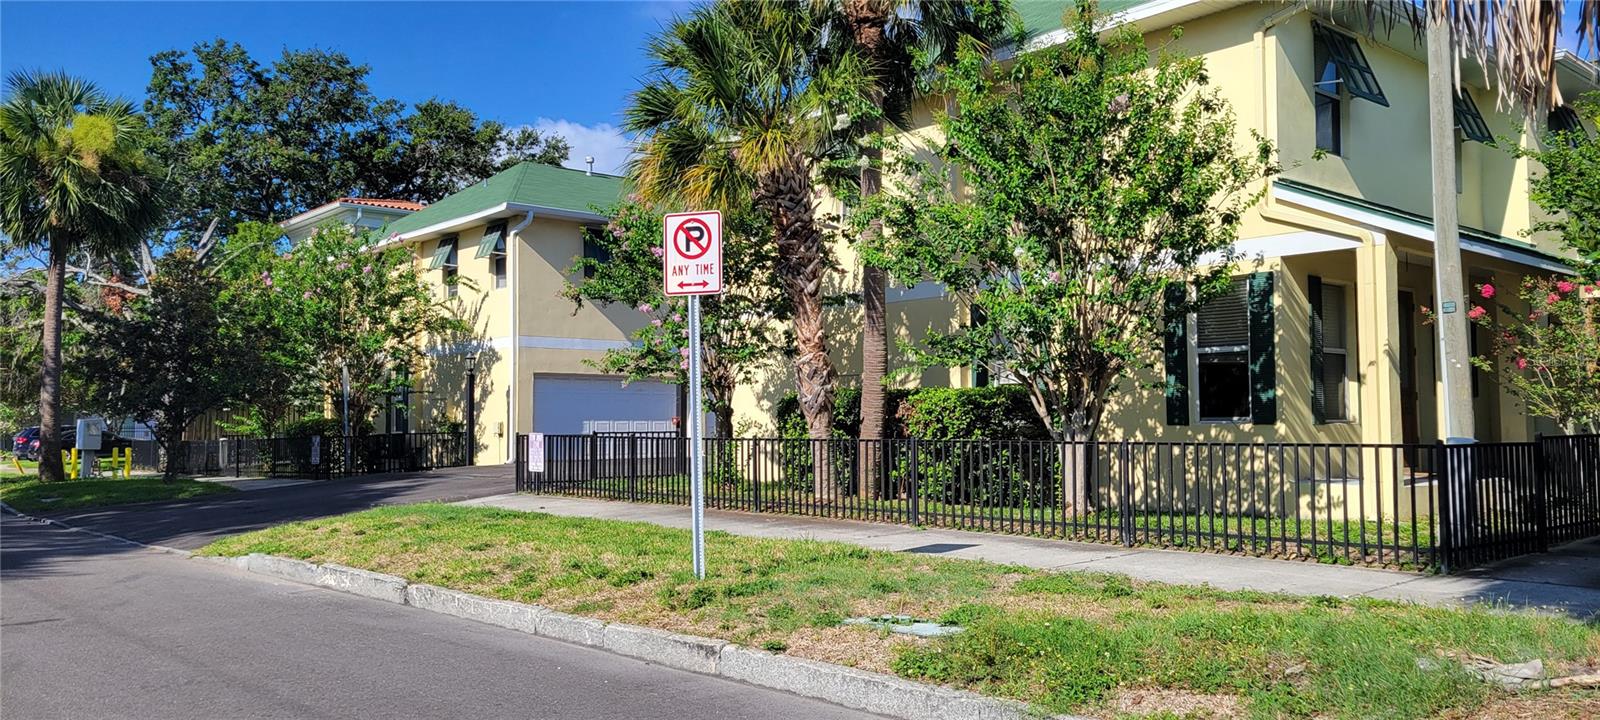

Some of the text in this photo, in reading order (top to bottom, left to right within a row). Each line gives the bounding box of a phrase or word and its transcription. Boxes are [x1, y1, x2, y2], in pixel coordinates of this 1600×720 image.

[685, 226, 704, 252] P
[672, 264, 714, 276] ANY TIME
